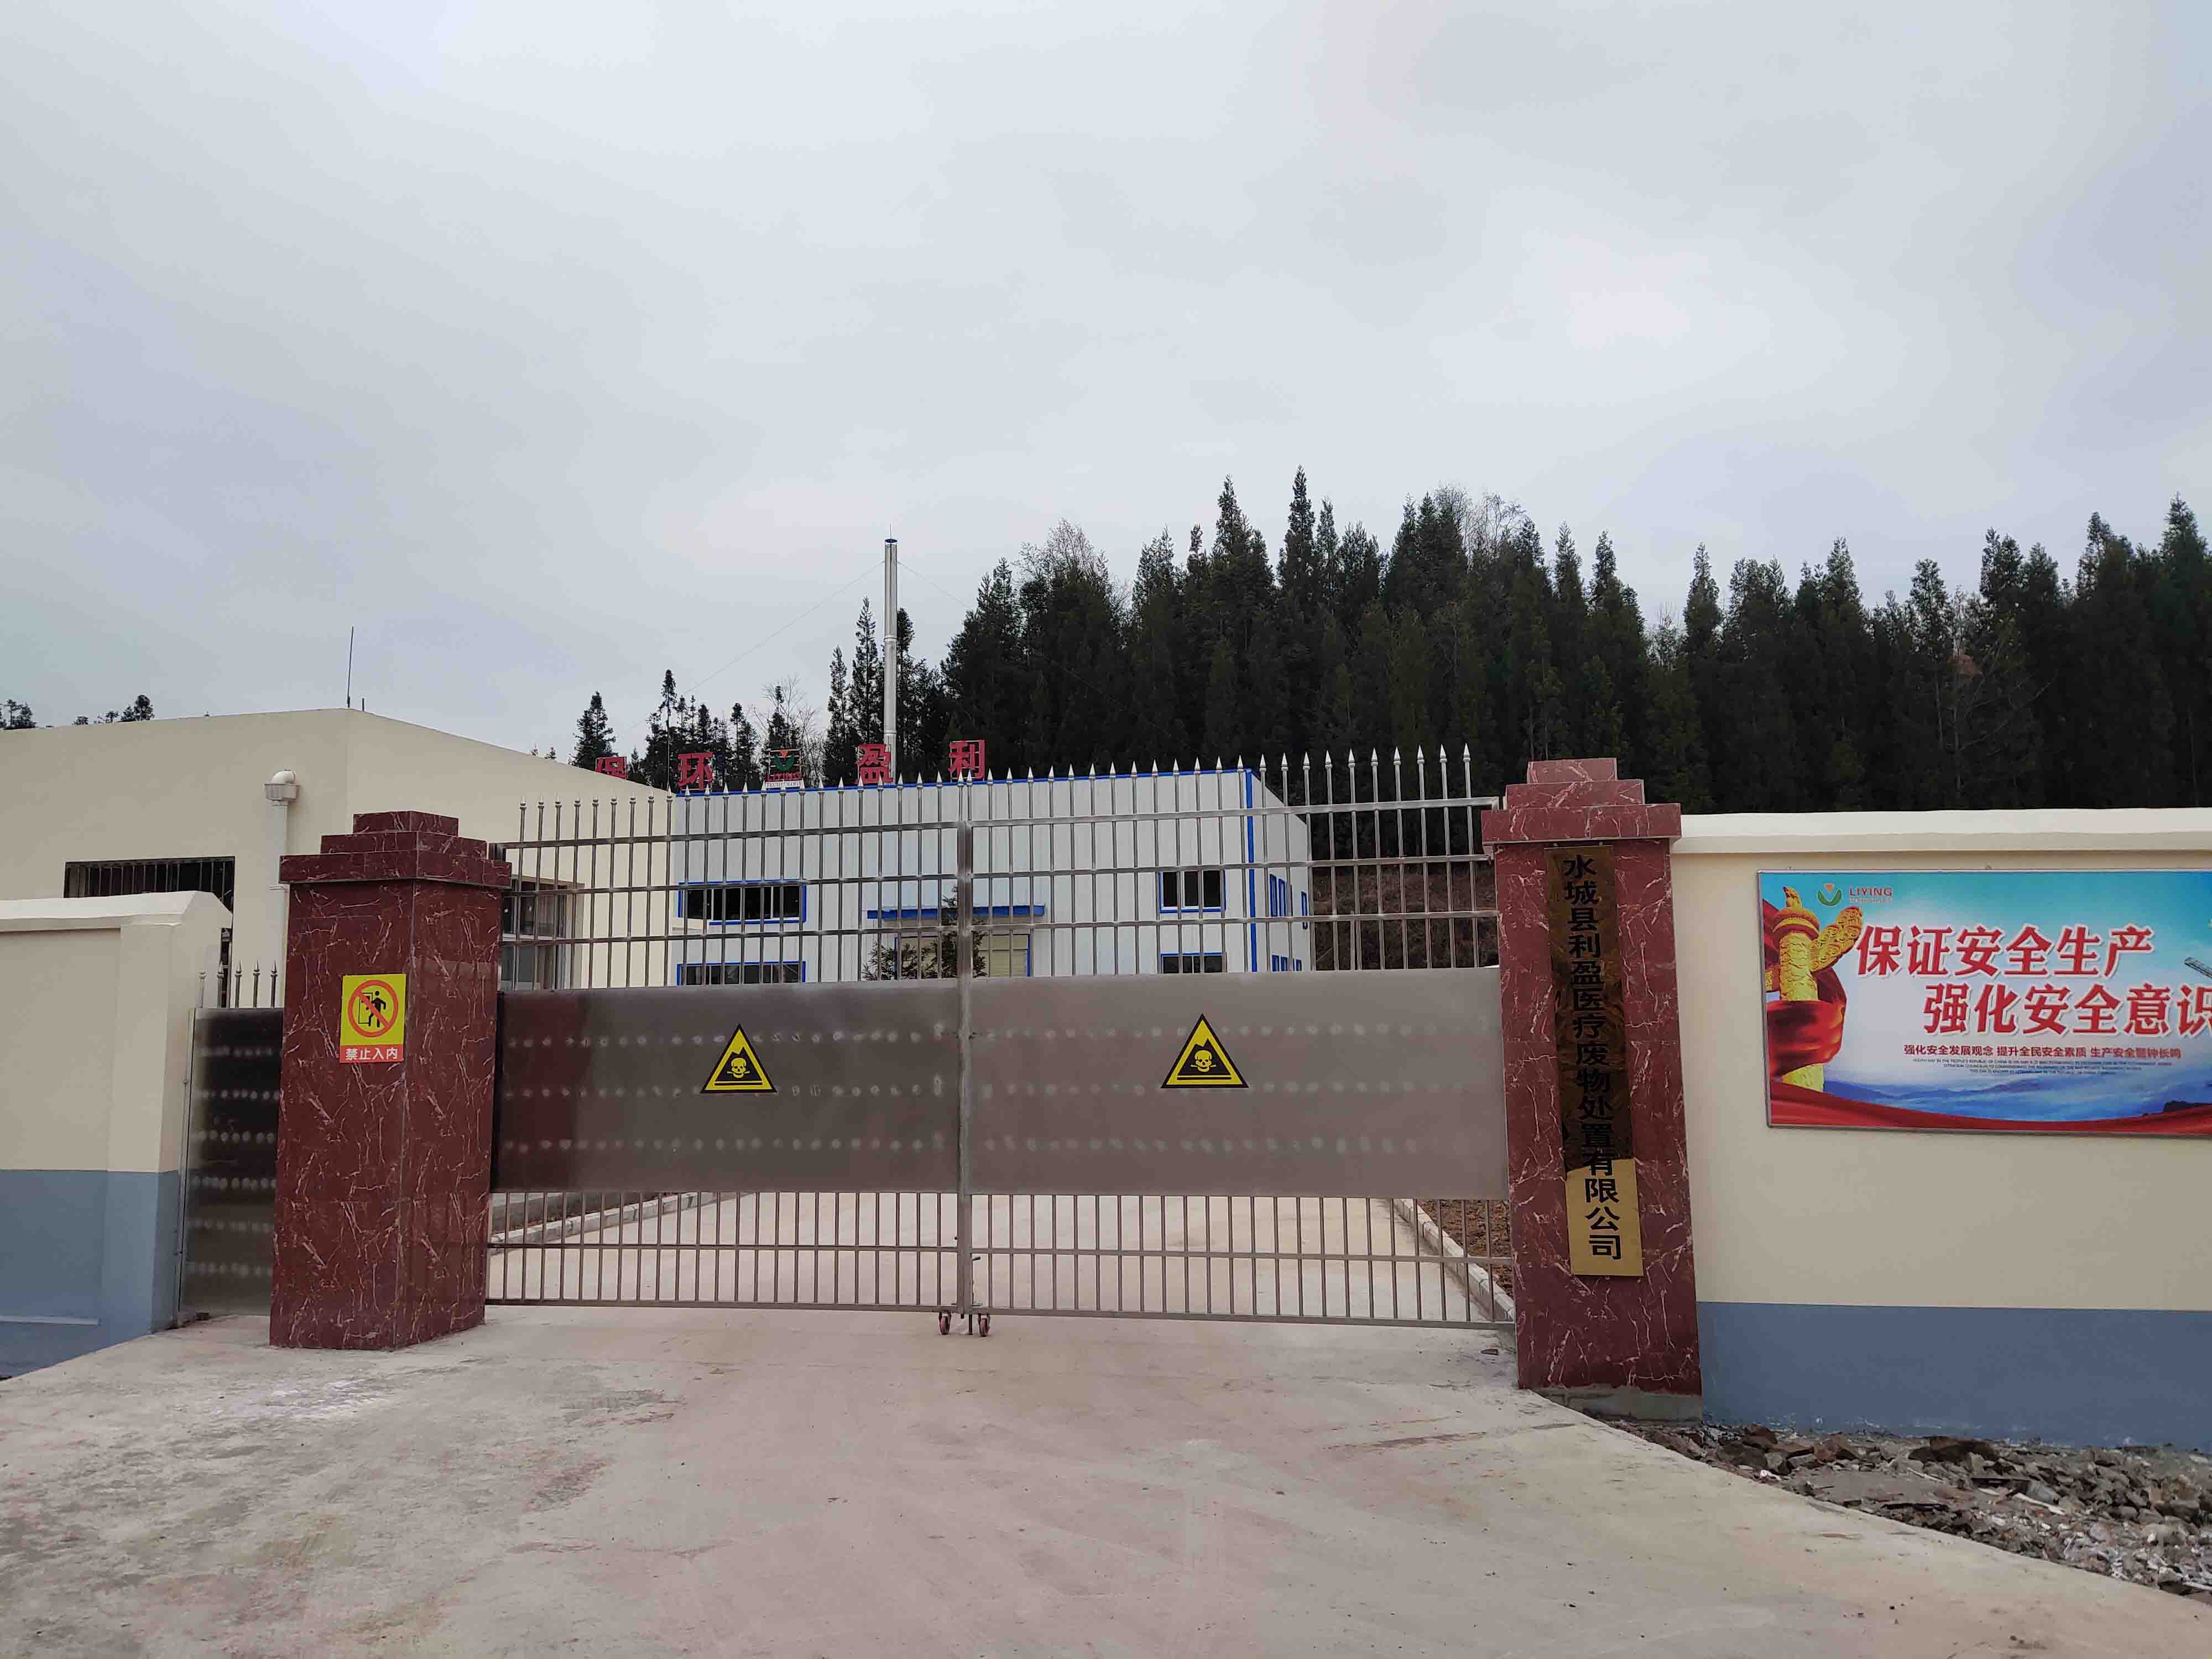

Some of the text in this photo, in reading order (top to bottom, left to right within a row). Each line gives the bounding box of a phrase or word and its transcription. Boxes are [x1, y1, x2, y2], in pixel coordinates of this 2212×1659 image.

[677, 752, 713, 791] 环
[855, 743, 894, 784] 盈
[948, 739, 985, 779] 利
[1849, 886, 1893, 896] LIYING
[1856, 925, 2153, 977] 保证安全生产
[1923, 983, 2212, 1036] 强化安全意识
[345, 1047, 398, 1061] 禁止入内
[1562, 854, 1623, 1260] 水城县利盈医疗废物处置有限公司
[1903, 1044, 1993, 1056] 强化安全发展观念
[1997, 1045, 2086, 1057] 提升全民安全素质
